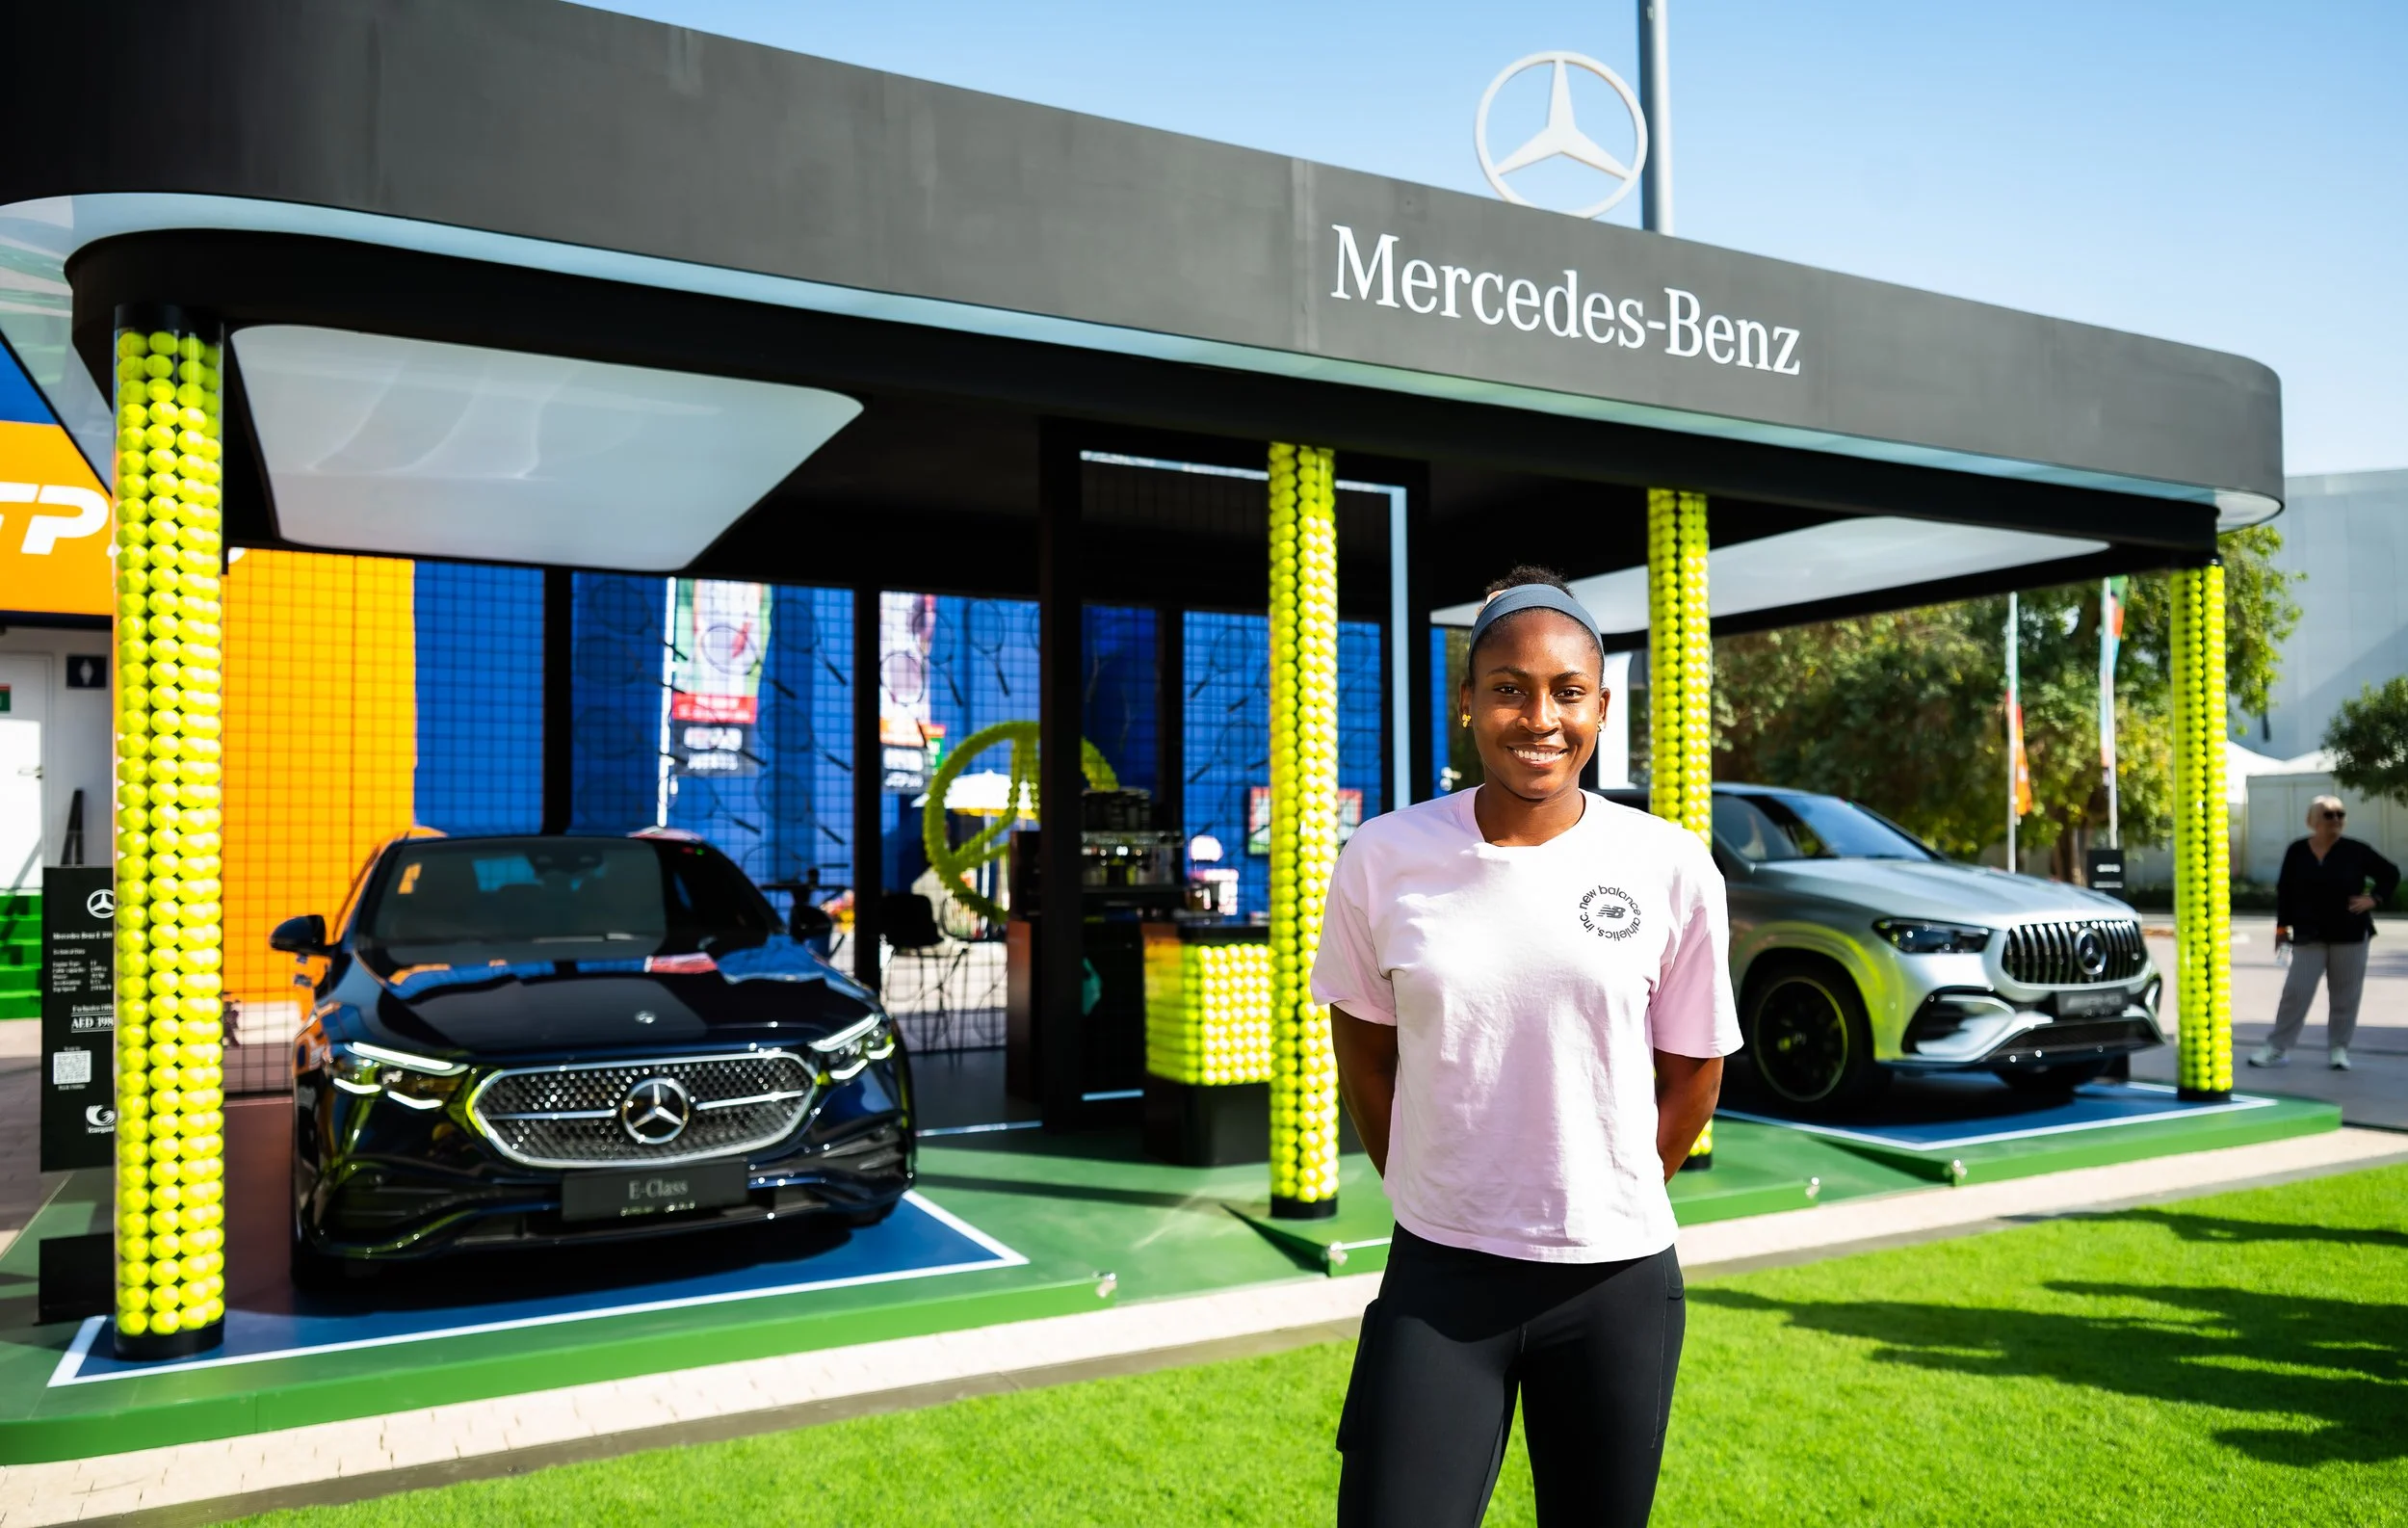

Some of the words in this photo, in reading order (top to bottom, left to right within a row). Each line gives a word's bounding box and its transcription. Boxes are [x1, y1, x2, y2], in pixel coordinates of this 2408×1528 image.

[1330, 224, 1801, 376] Mercedes-Benz
[1579, 889, 1597, 909] new
[1598, 884, 1641, 916] balance
[1580, 911, 1595, 933] inc.
[71, 1016, 94, 1029] AED
[629, 1178, 689, 1200] E-Class
